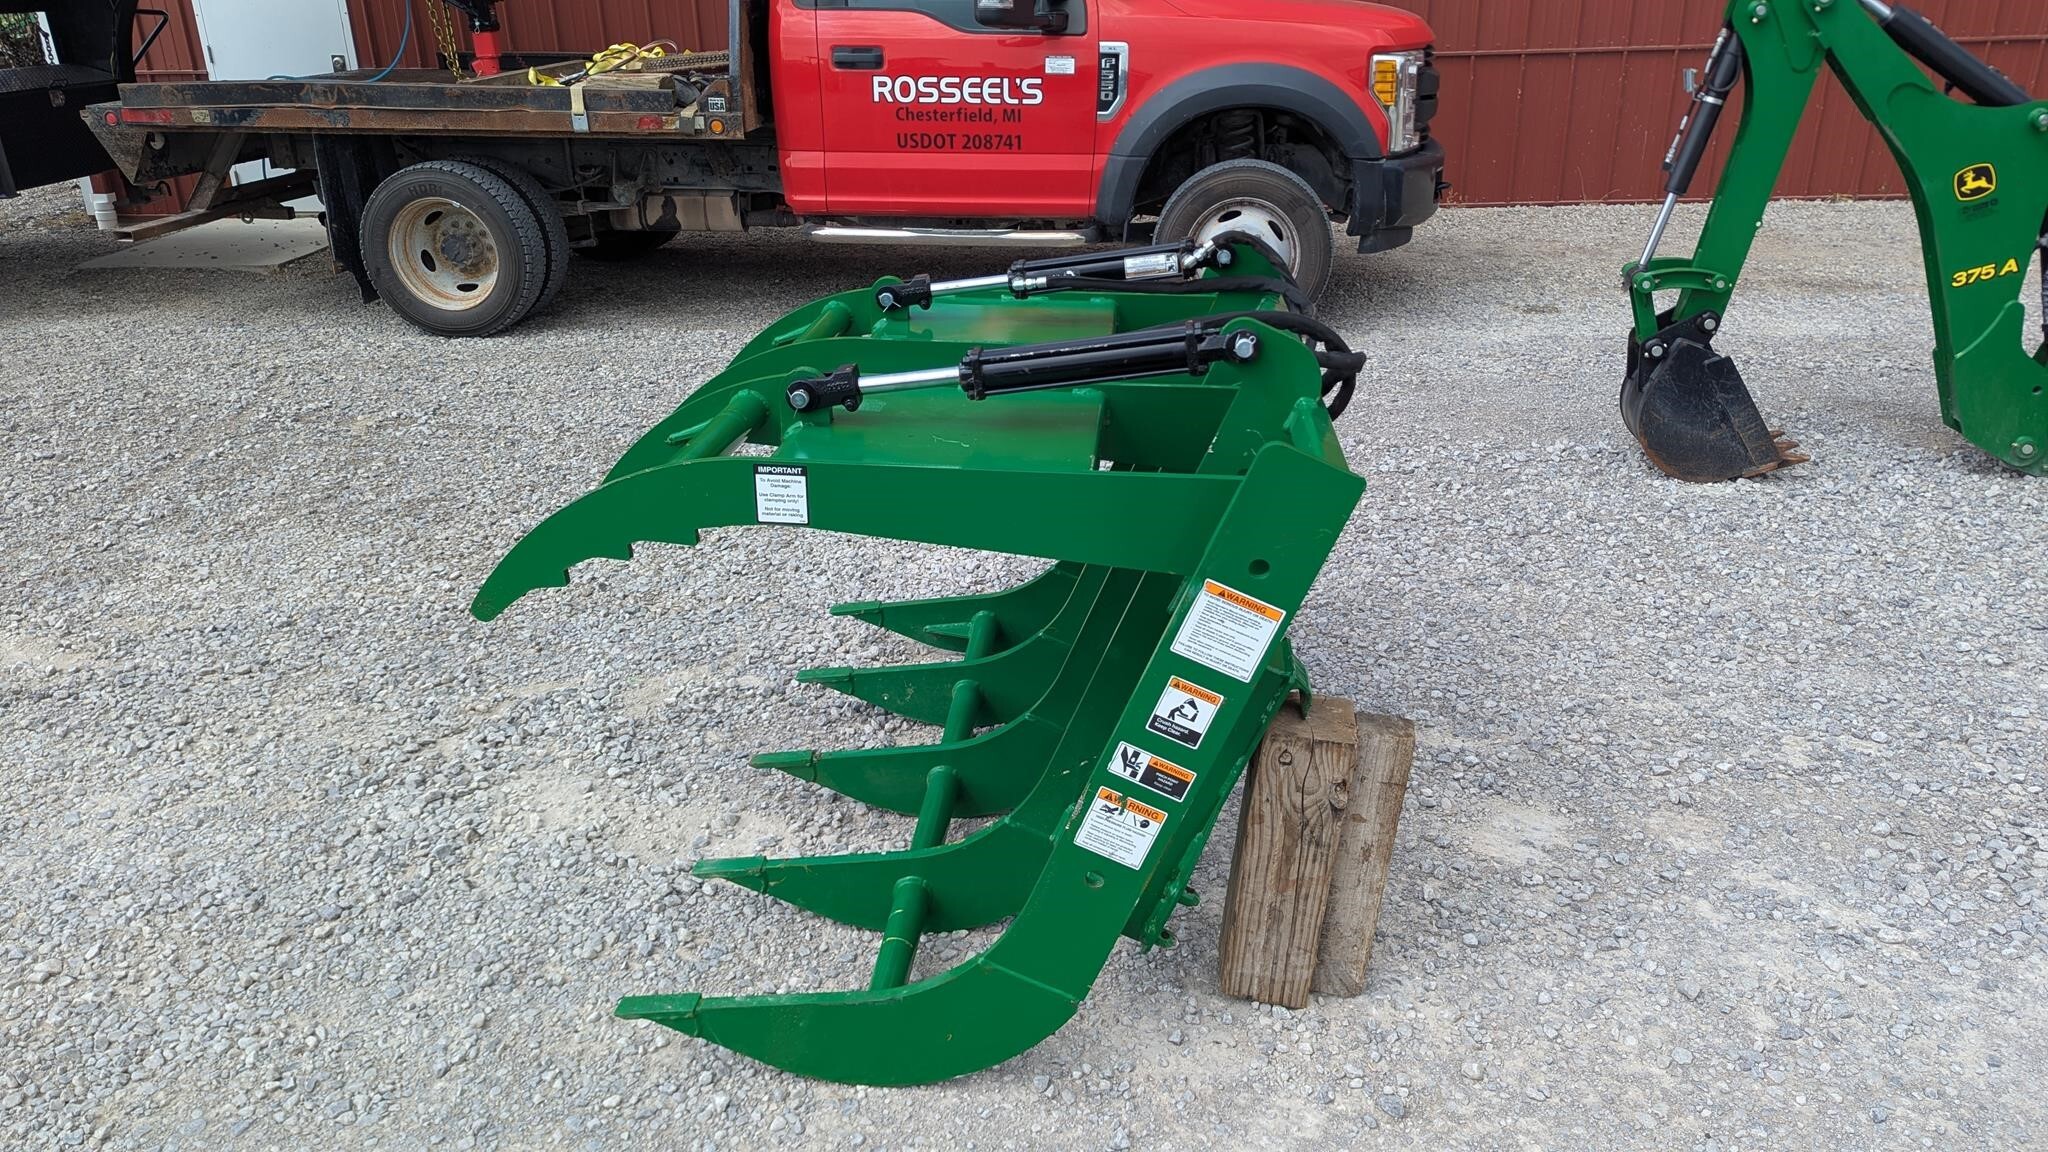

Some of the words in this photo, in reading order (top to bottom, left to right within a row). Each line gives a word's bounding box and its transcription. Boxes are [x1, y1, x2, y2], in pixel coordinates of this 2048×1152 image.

[872, 75, 1043, 105] ROSSEEL'S
[709, 102, 725, 111] USA
[895, 106, 998, 124] Chesterfield,
[1002, 109, 1022, 122] MI
[896, 133, 956, 149] USDOT
[962, 134, 1022, 150] 208741
[1951, 263, 1996, 288] 375
[1998, 257, 2019, 276] A
[757, 466, 802, 475] IMPORTANT
[1225, 591, 1267, 614] WARNING
[1181, 683, 1217, 703] WARNING
[1153, 721, 1167, 731] Keep
[1155, 716, 1172, 727] Crush
[1159, 763, 1190, 779] WARNING
[1114, 794, 1159, 820] WRNING
